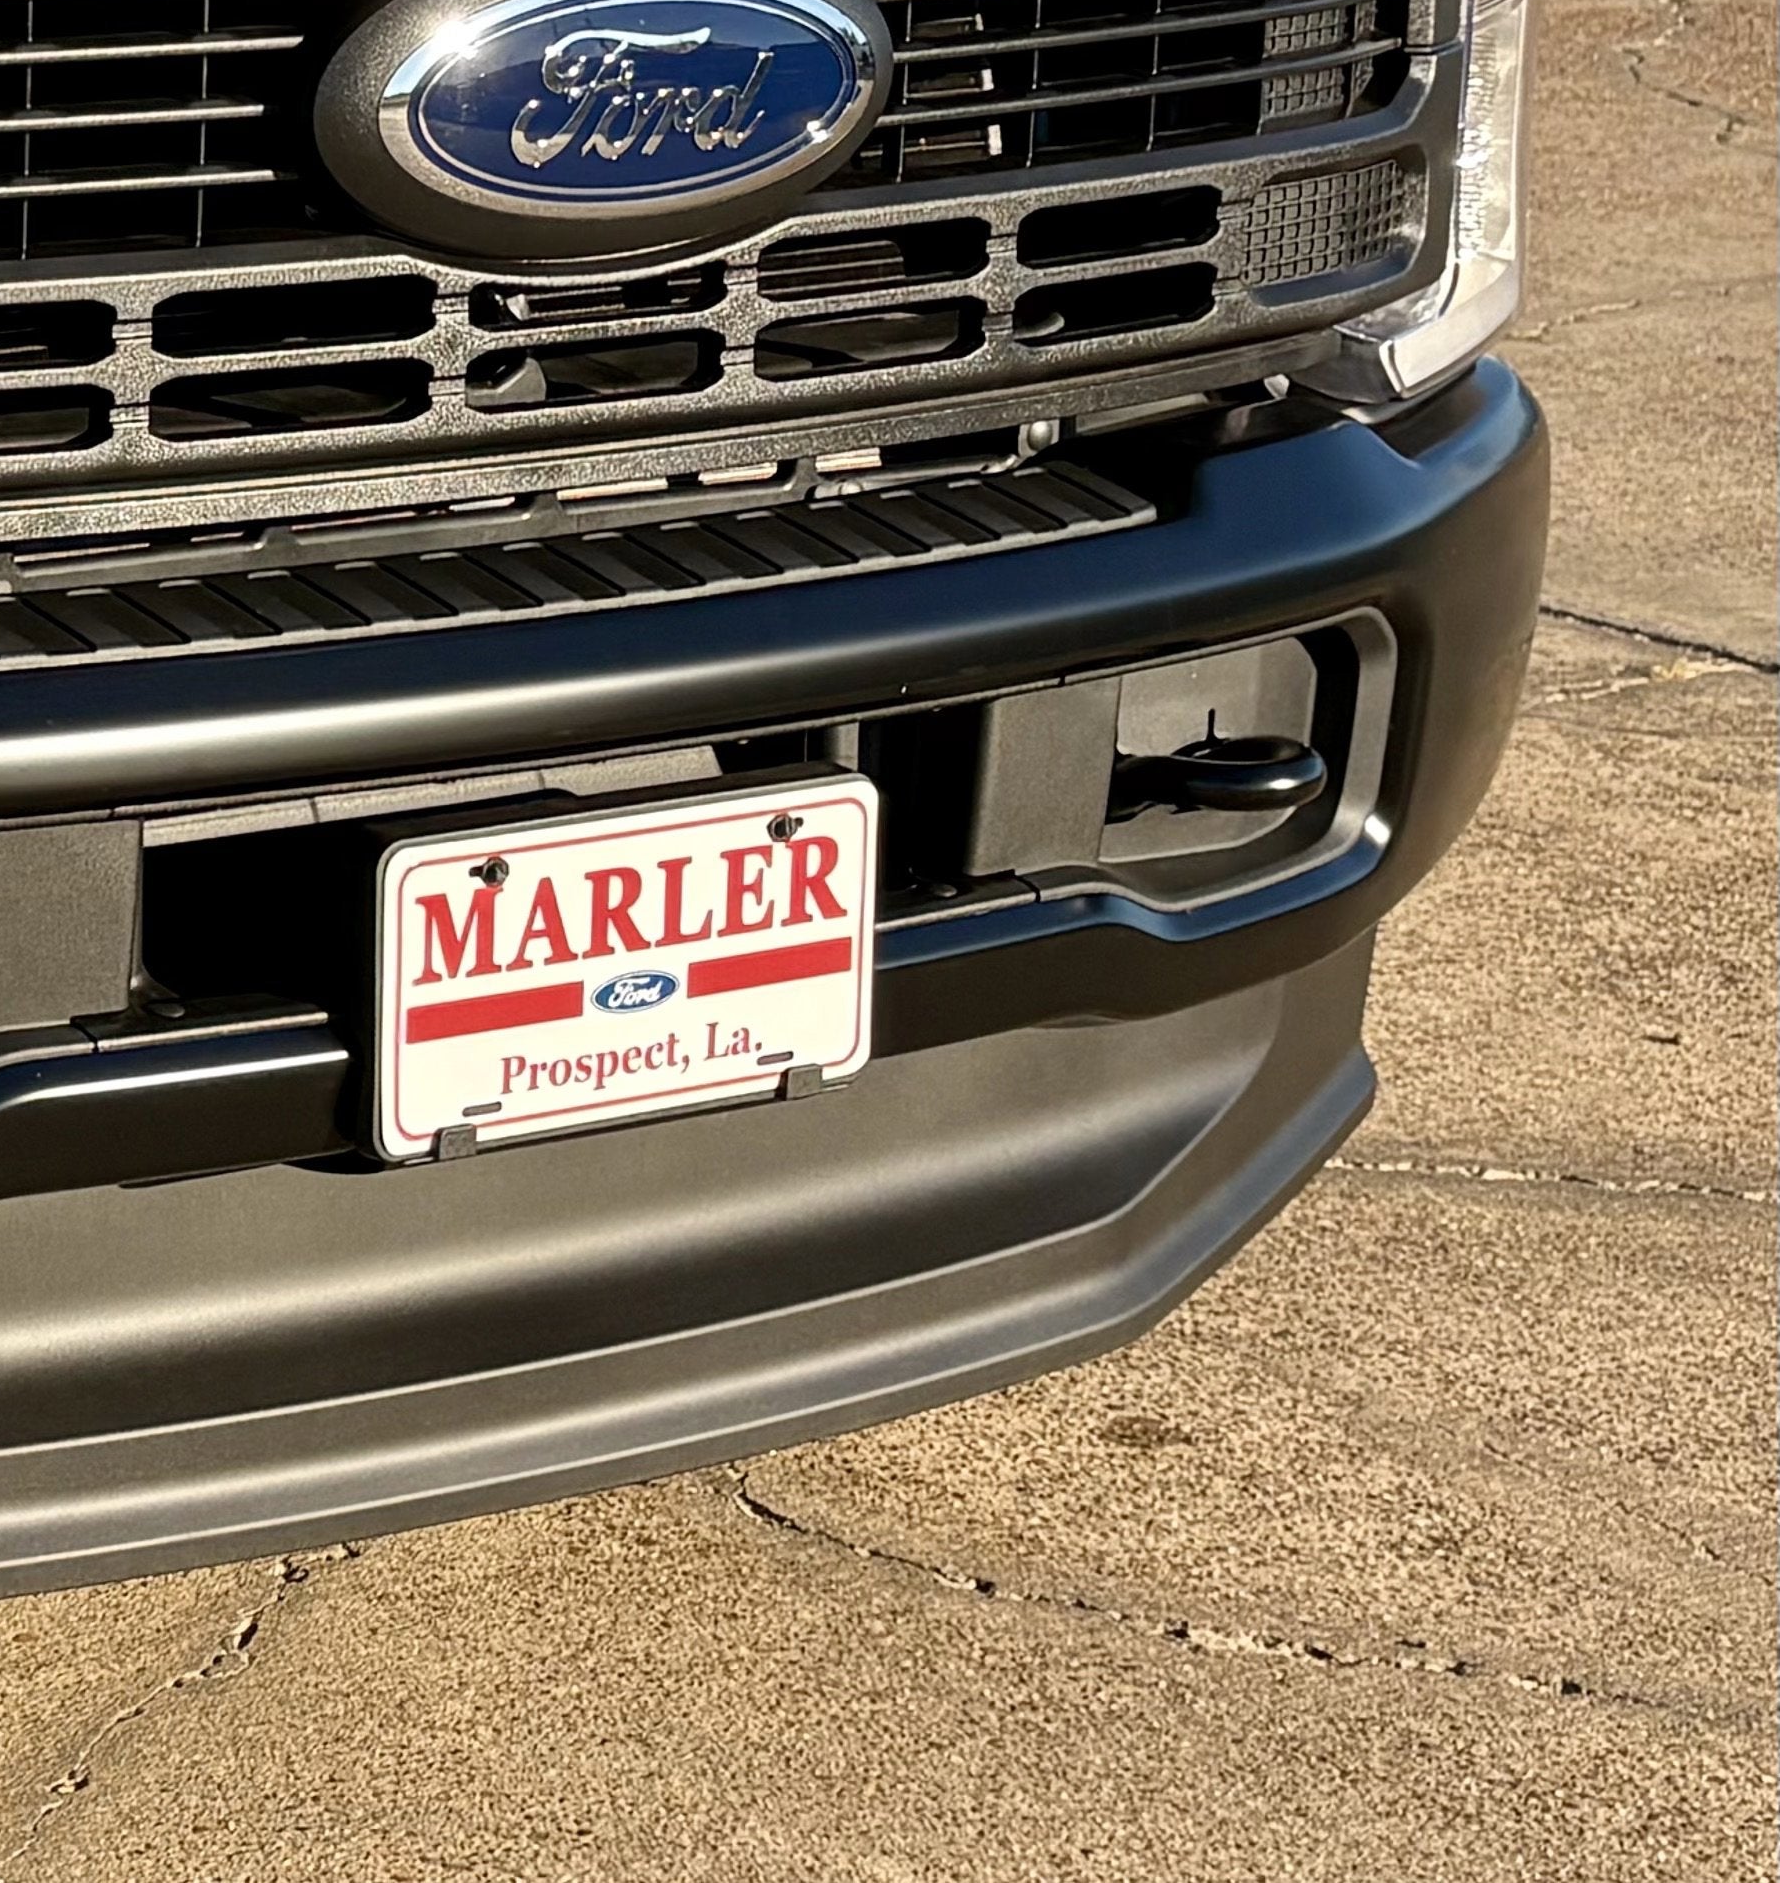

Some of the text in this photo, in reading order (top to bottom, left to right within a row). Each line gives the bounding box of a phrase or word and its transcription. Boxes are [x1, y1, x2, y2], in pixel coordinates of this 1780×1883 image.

[511, 26, 774, 169] Ford
[412, 835, 848, 985] MARLER
[606, 975, 663, 1010] Ford
[500, 1021, 764, 1095] Prospect, La.
